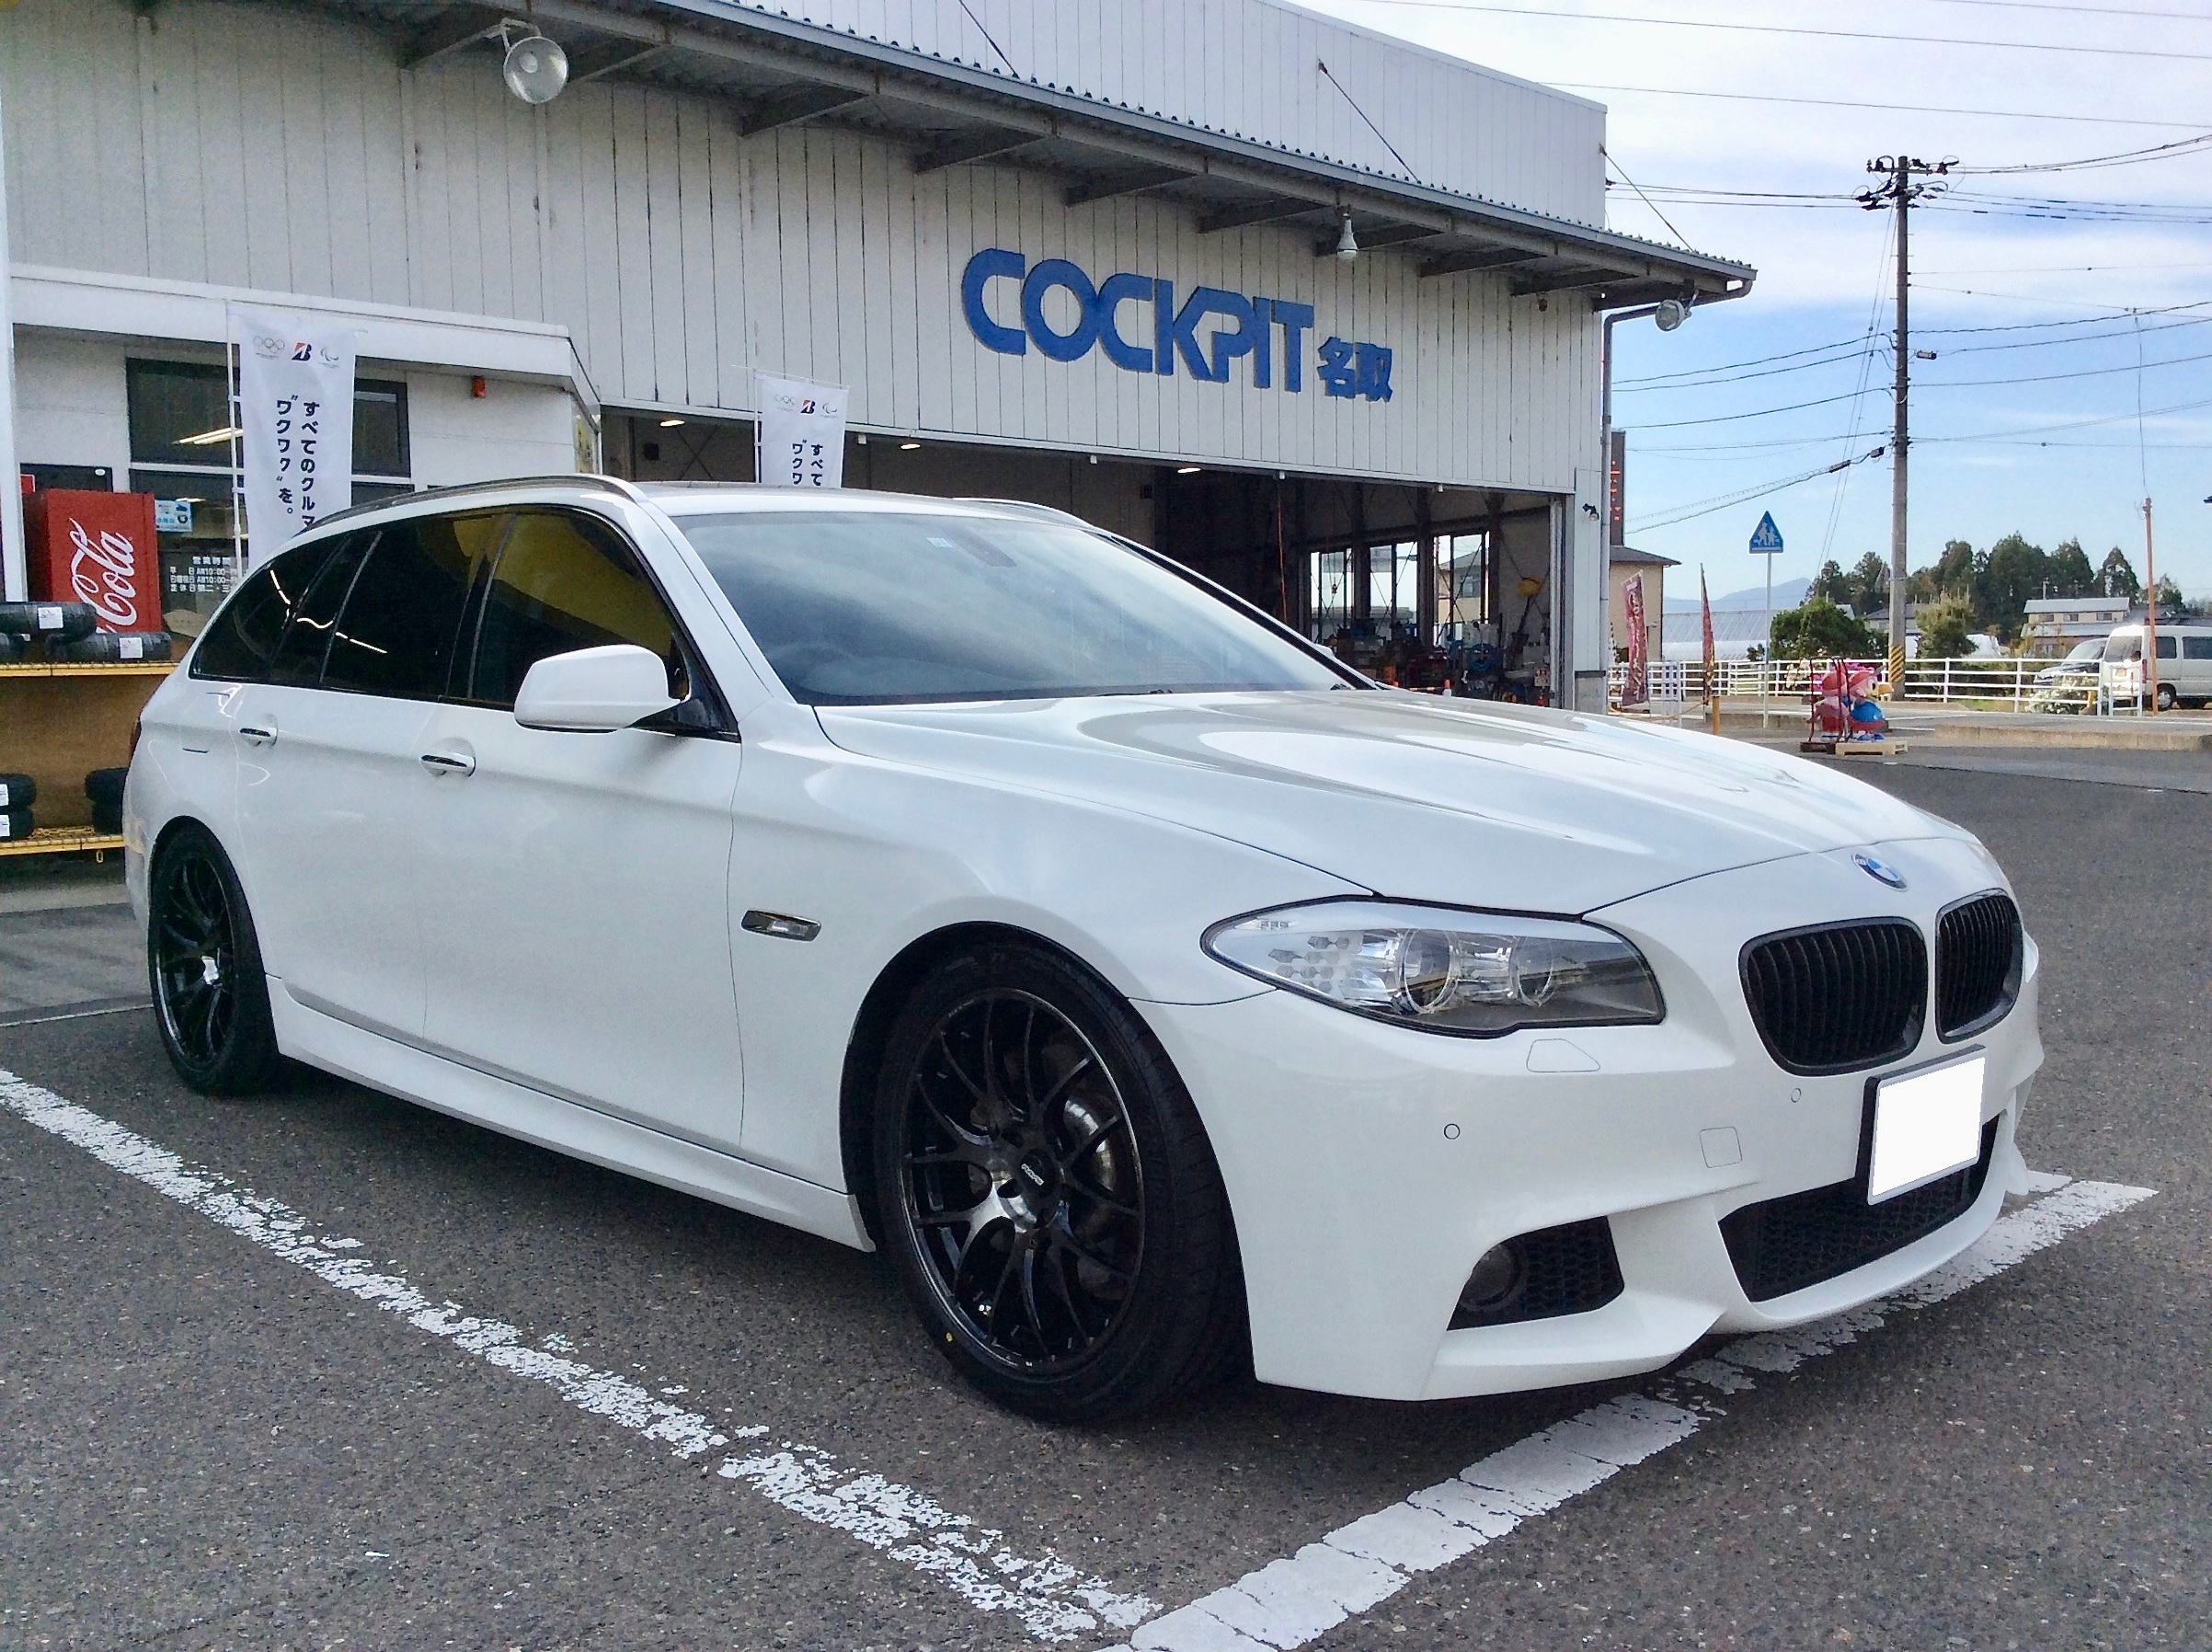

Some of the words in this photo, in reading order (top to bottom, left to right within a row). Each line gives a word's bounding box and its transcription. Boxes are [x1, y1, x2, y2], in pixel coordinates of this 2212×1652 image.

[961, 247, 1314, 394] COCKPIT
[1317, 336, 1393, 403] 名取
[300, 401, 320, 527] すべてのクルマ
[810, 443, 823, 486] すべて
